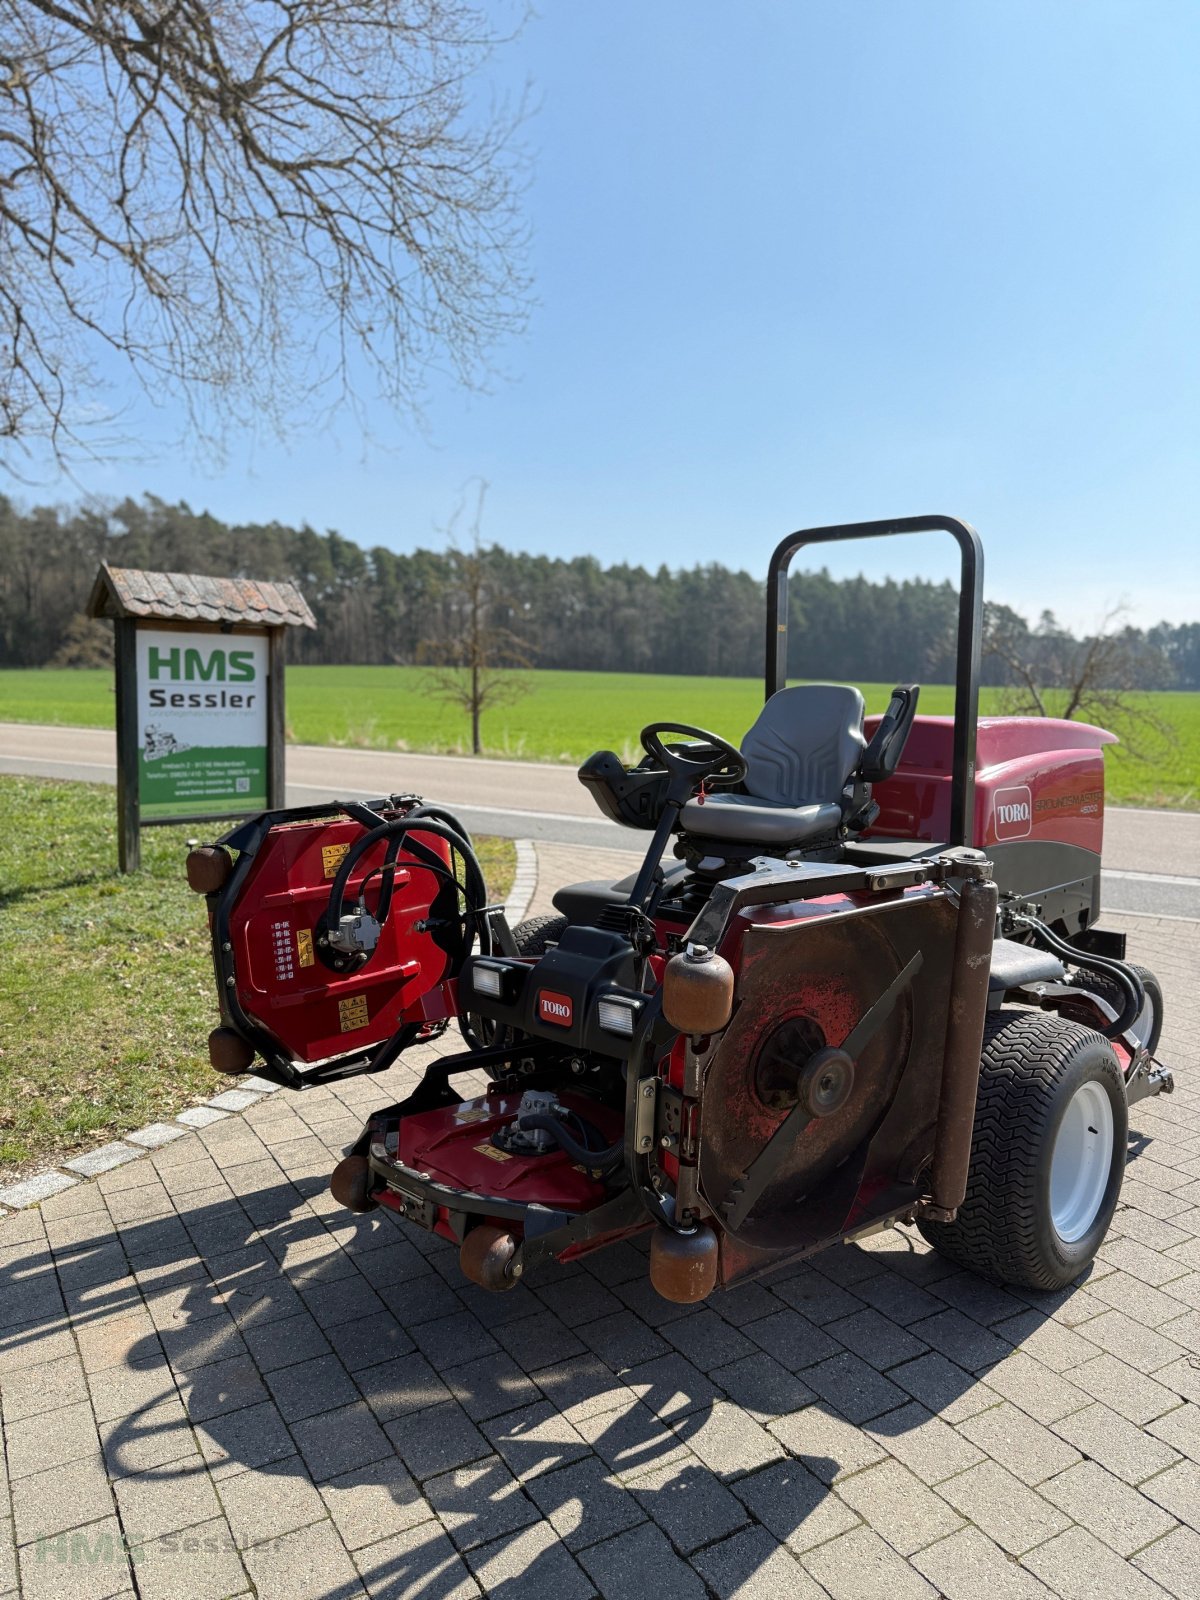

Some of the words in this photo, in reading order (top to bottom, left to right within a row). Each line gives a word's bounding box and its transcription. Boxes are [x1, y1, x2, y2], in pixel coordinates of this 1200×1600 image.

[148, 646, 256, 682] HMS
[149, 689, 256, 709] Sessler
[997, 802, 1029, 824] TORO
[541, 999, 570, 1018] TORO
